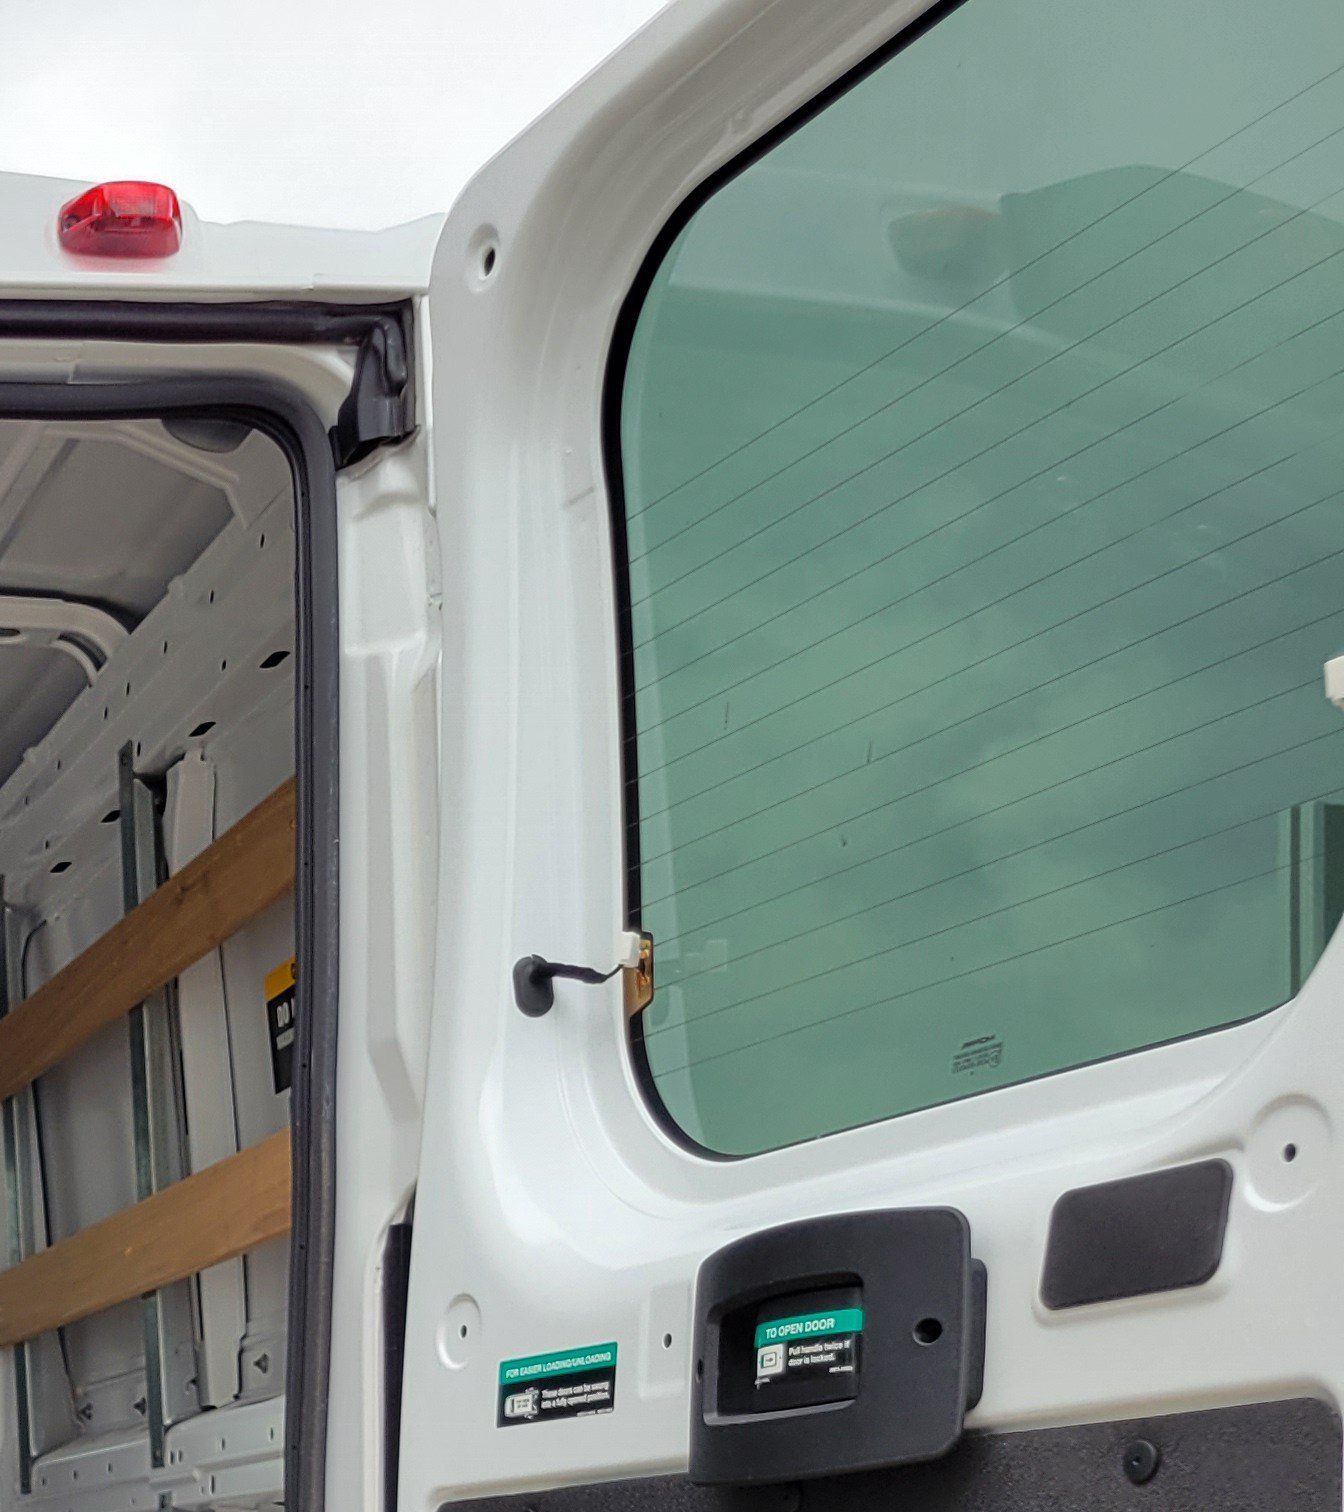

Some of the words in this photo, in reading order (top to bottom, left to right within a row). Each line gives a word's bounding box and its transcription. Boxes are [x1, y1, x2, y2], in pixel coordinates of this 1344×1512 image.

[765, 1327, 777, 1339] TO
[778, 1322, 804, 1336] OPEN
[805, 1317, 835, 1333] DOOR
[789, 1346, 801, 1356] Pull
[801, 1343, 823, 1354] handle
[824, 1341, 843, 1351] twice
[788, 1357, 803, 1367] door
[505, 1367, 519, 1379] FOR
[520, 1363, 542, 1376] EASIER
